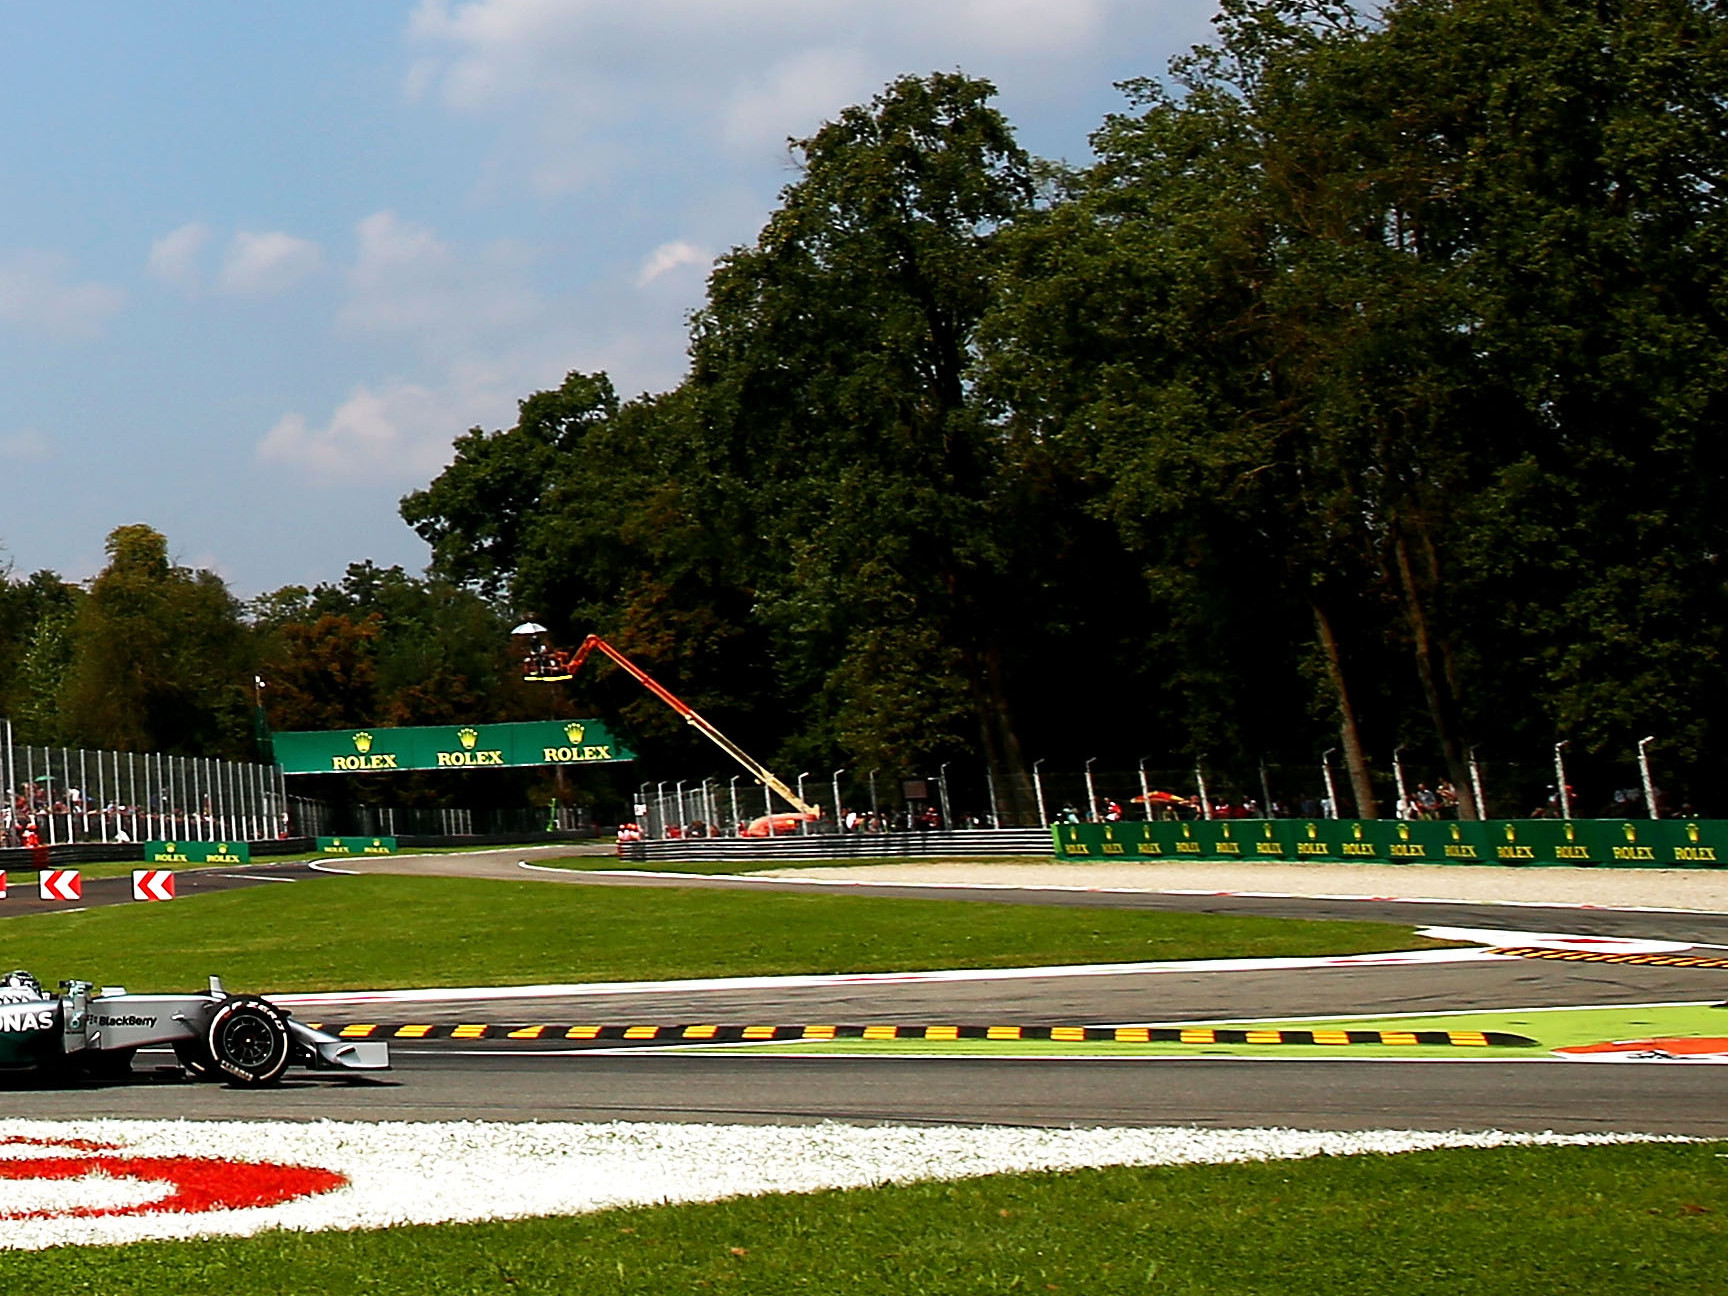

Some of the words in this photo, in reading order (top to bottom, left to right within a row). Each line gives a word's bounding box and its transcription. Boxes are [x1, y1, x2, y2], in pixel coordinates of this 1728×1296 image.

[437, 751, 503, 767] ROLEX
[544, 746, 611, 762] ROLEX
[332, 755, 397, 771] ROLEX
[154, 854, 189, 862] ROLEX
[205, 854, 240, 863] ROLEX
[1612, 846, 1655, 860] ROLEX
[1673, 847, 1717, 860] ROLEX
[98, 1015, 158, 1028] BlackBerry
